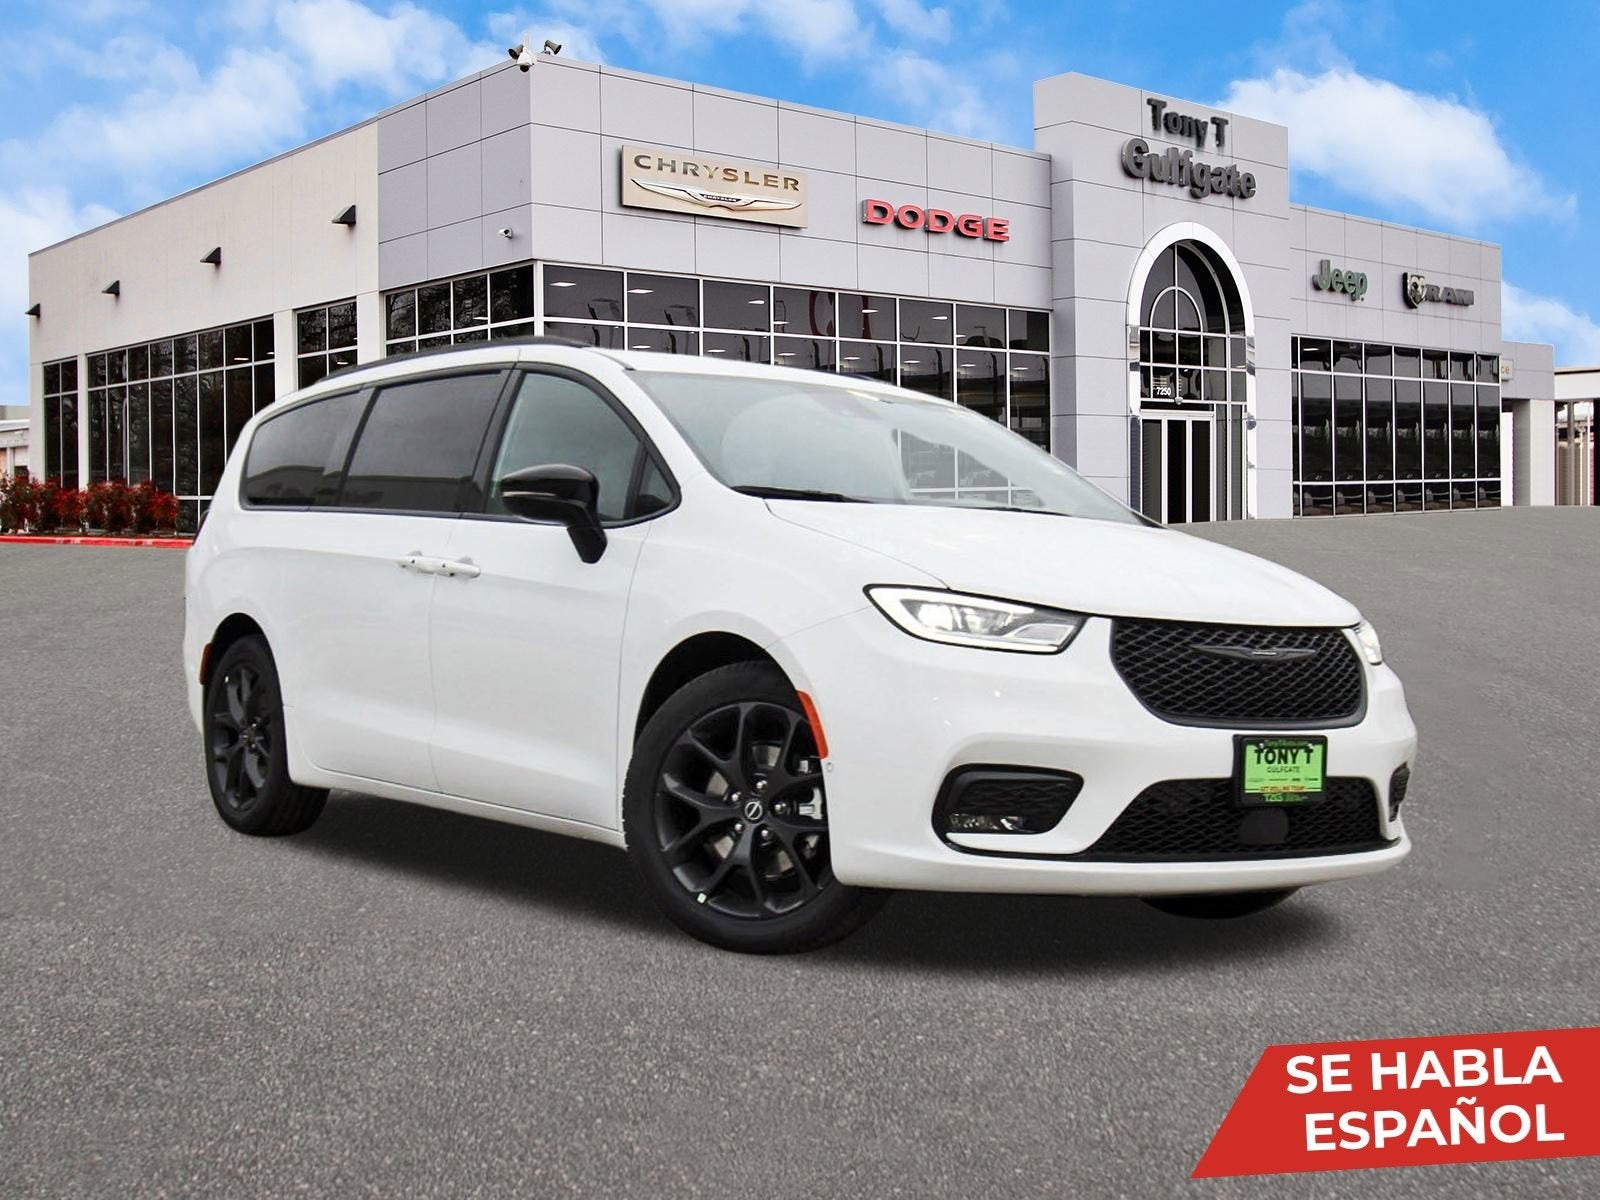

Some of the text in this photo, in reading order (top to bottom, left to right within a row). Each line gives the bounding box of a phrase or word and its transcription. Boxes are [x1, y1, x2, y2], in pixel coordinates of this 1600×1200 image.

[1146, 98, 1229, 148] Tony T
[634, 154, 800, 191] CHRYSLER
[1121, 138, 1256, 199] Gulfgate
[862, 198, 1010, 242] DODGE
[1312, 259, 1368, 302] Jeep
[1425, 283, 1475, 307] RAM
[1156, 386, 1172, 396] 7250
[1254, 747, 1314, 765] TONY T
